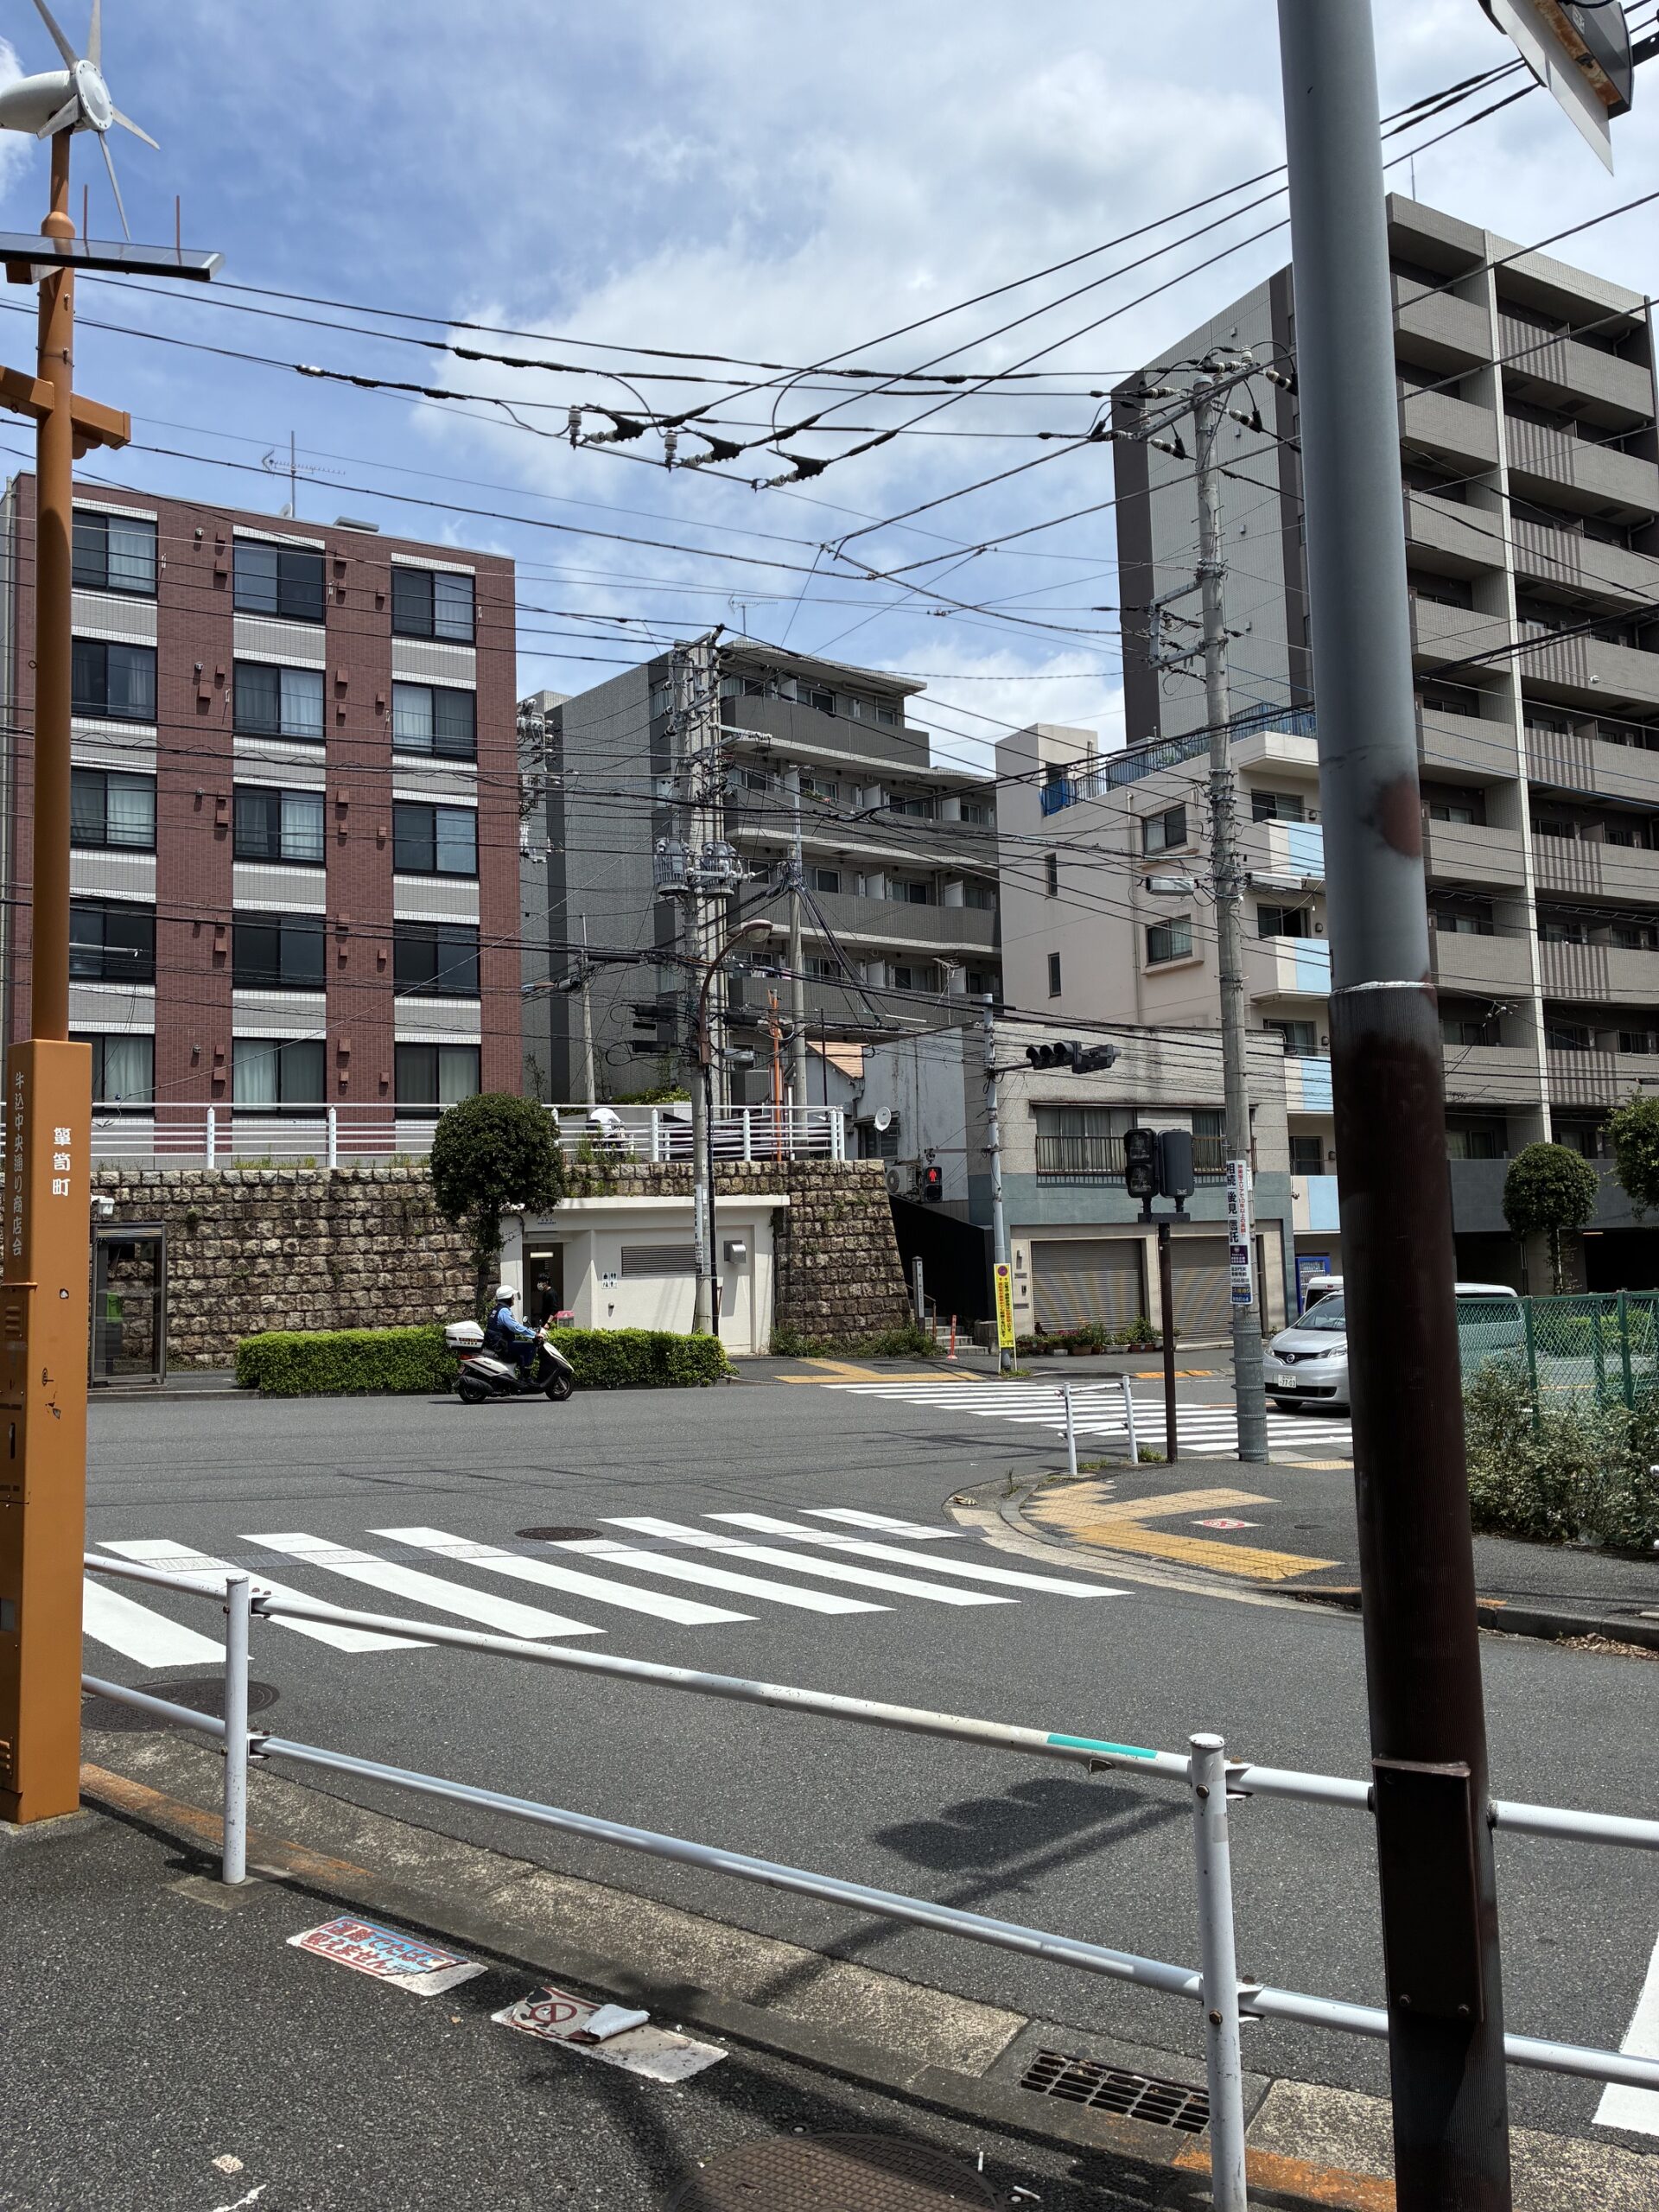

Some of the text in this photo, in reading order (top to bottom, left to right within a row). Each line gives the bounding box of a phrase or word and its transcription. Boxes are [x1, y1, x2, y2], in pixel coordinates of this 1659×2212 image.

[13, 1071, 24, 1255] 牛込中央通り商店会
[302, 1931, 394, 1969] 吸えません
